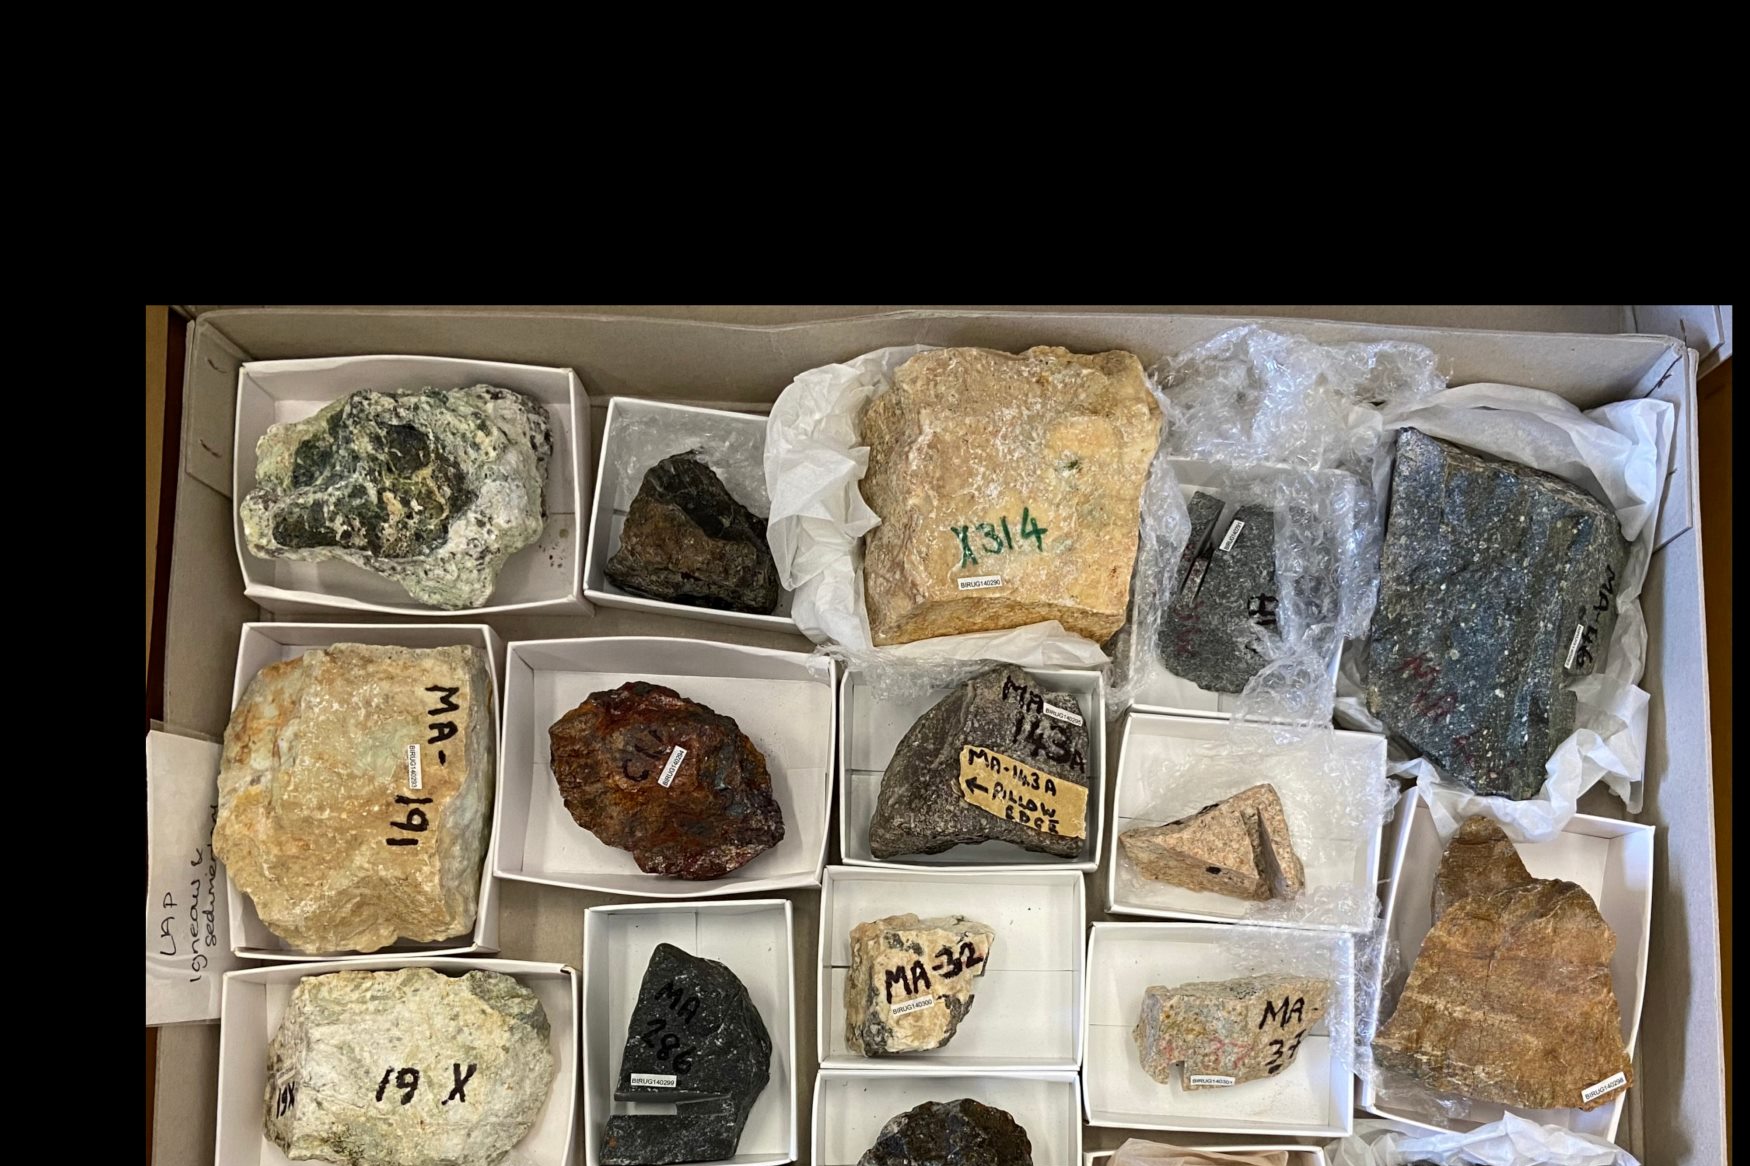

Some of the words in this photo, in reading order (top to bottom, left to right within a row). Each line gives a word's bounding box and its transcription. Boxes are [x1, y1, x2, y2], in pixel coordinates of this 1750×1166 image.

[959, 579, 1001, 589] BIRUG140290
[160, 892, 178, 956] LAP
[375, 1067, 420, 1105] 19
[441, 1063, 477, 1105] X
[631, 1078, 675, 1086] BIRUG140299
